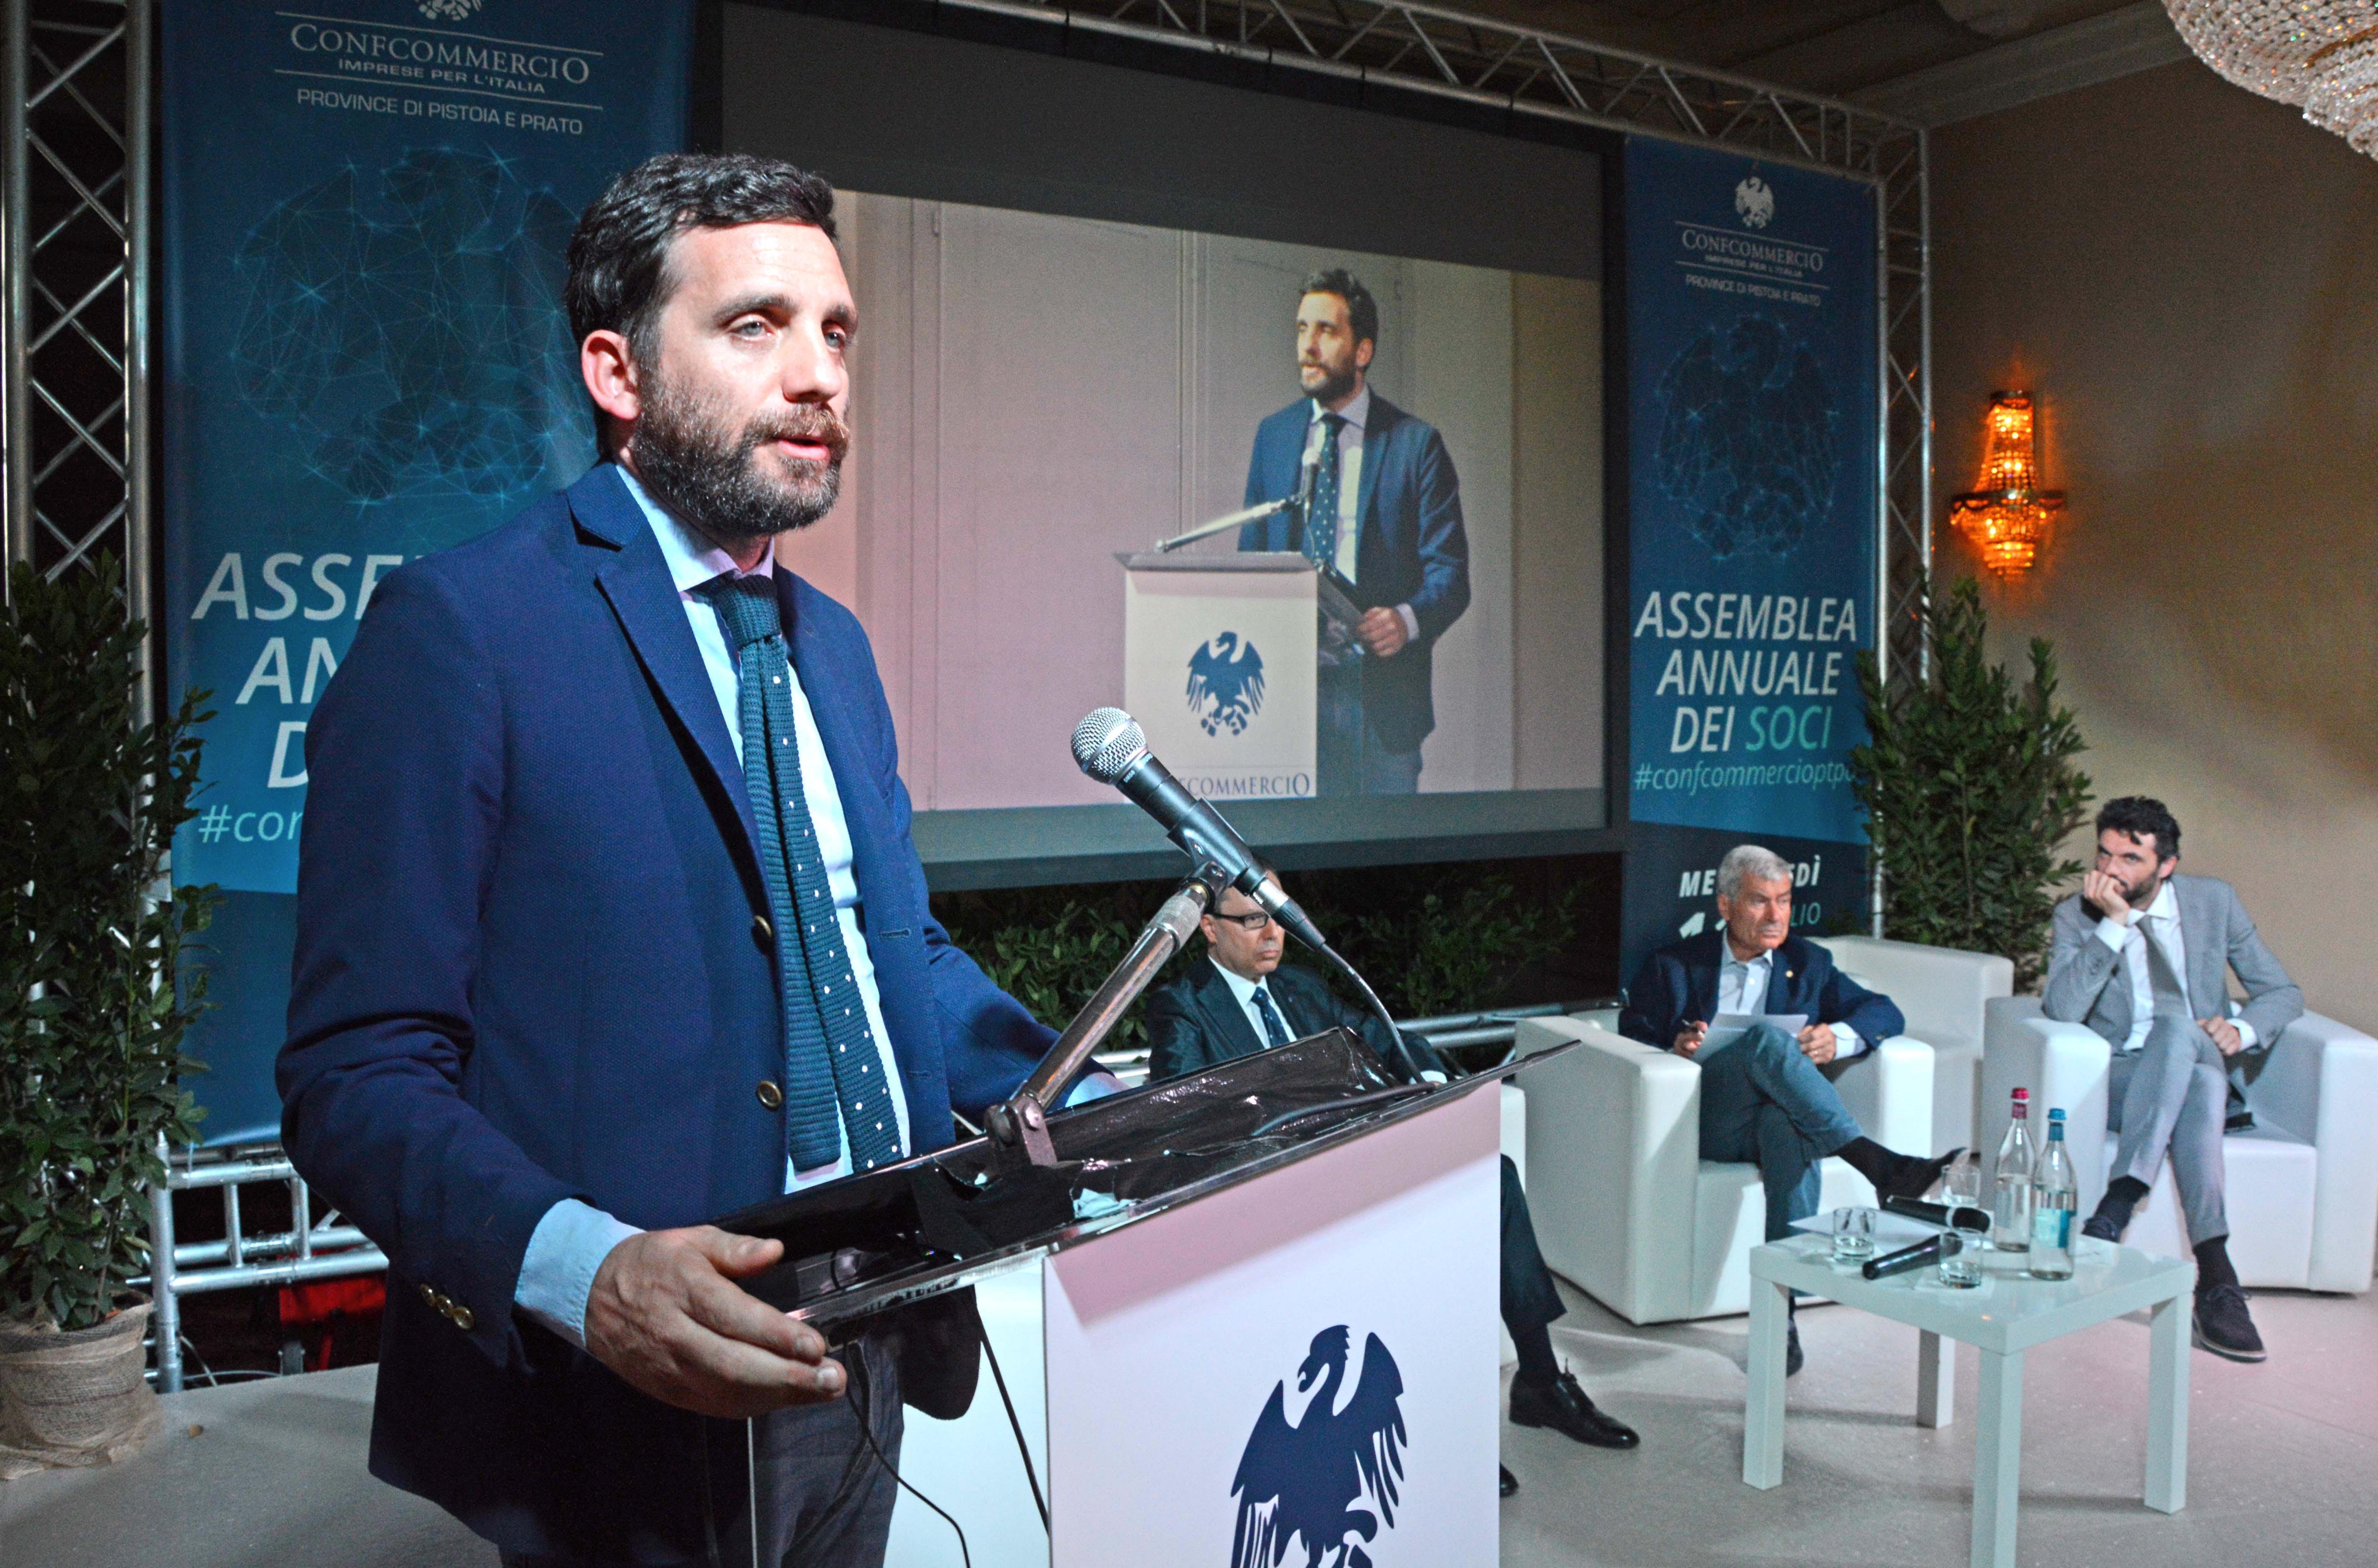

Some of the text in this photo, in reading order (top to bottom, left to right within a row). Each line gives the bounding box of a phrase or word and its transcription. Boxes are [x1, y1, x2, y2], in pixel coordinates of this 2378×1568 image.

[291, 23, 589, 83] CONFCOMMERCIO
[338, 58, 545, 94] IMPRESE PER L'ITALIA
[297, 89, 583, 135] PROVINCE DI PISTOIA E PRATO
[1682, 229, 1824, 271] CONFCOMMERCIO
[191, 552, 424, 621] ASSE
[1633, 591, 1857, 642] ASSEMBLEA
[1655, 649, 1843, 696] ANNUALE
[1671, 705, 1832, 753] DEI SOCI
